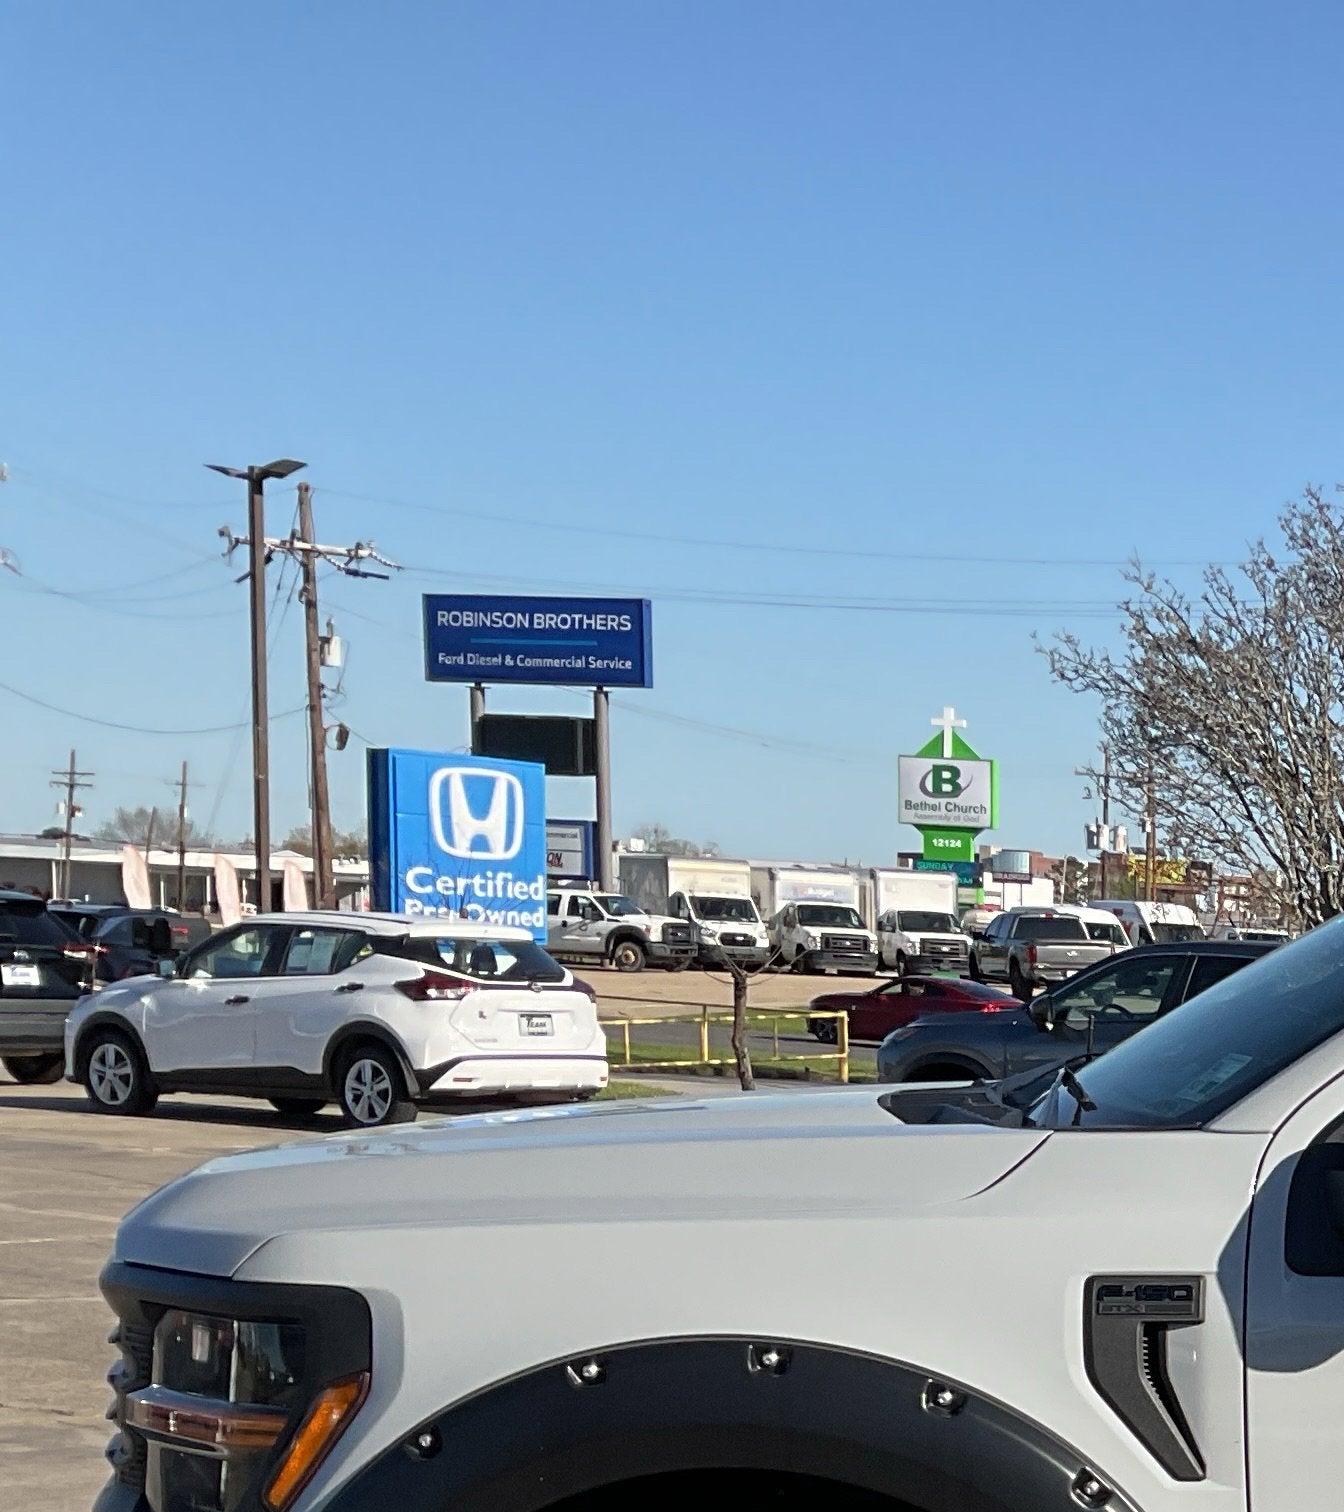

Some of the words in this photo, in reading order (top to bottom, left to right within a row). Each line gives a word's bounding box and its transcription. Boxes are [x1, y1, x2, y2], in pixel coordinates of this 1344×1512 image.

[437, 610, 529, 628] ROBINSON
[533, 613, 632, 631] BROTHERS
[438, 652, 464, 665] Ford
[467, 653, 502, 666] Diesel
[505, 655, 514, 667] &
[516, 655, 585, 669] Commercial
[588, 656, 632, 670] Service
[932, 764, 961, 794] B
[904, 799, 942, 812] Bethel
[944, 801, 987, 815] Church
[932, 838, 962, 848] 12124
[917, 861, 954, 871] SUNDAY
[405, 866, 544, 901] Certified
